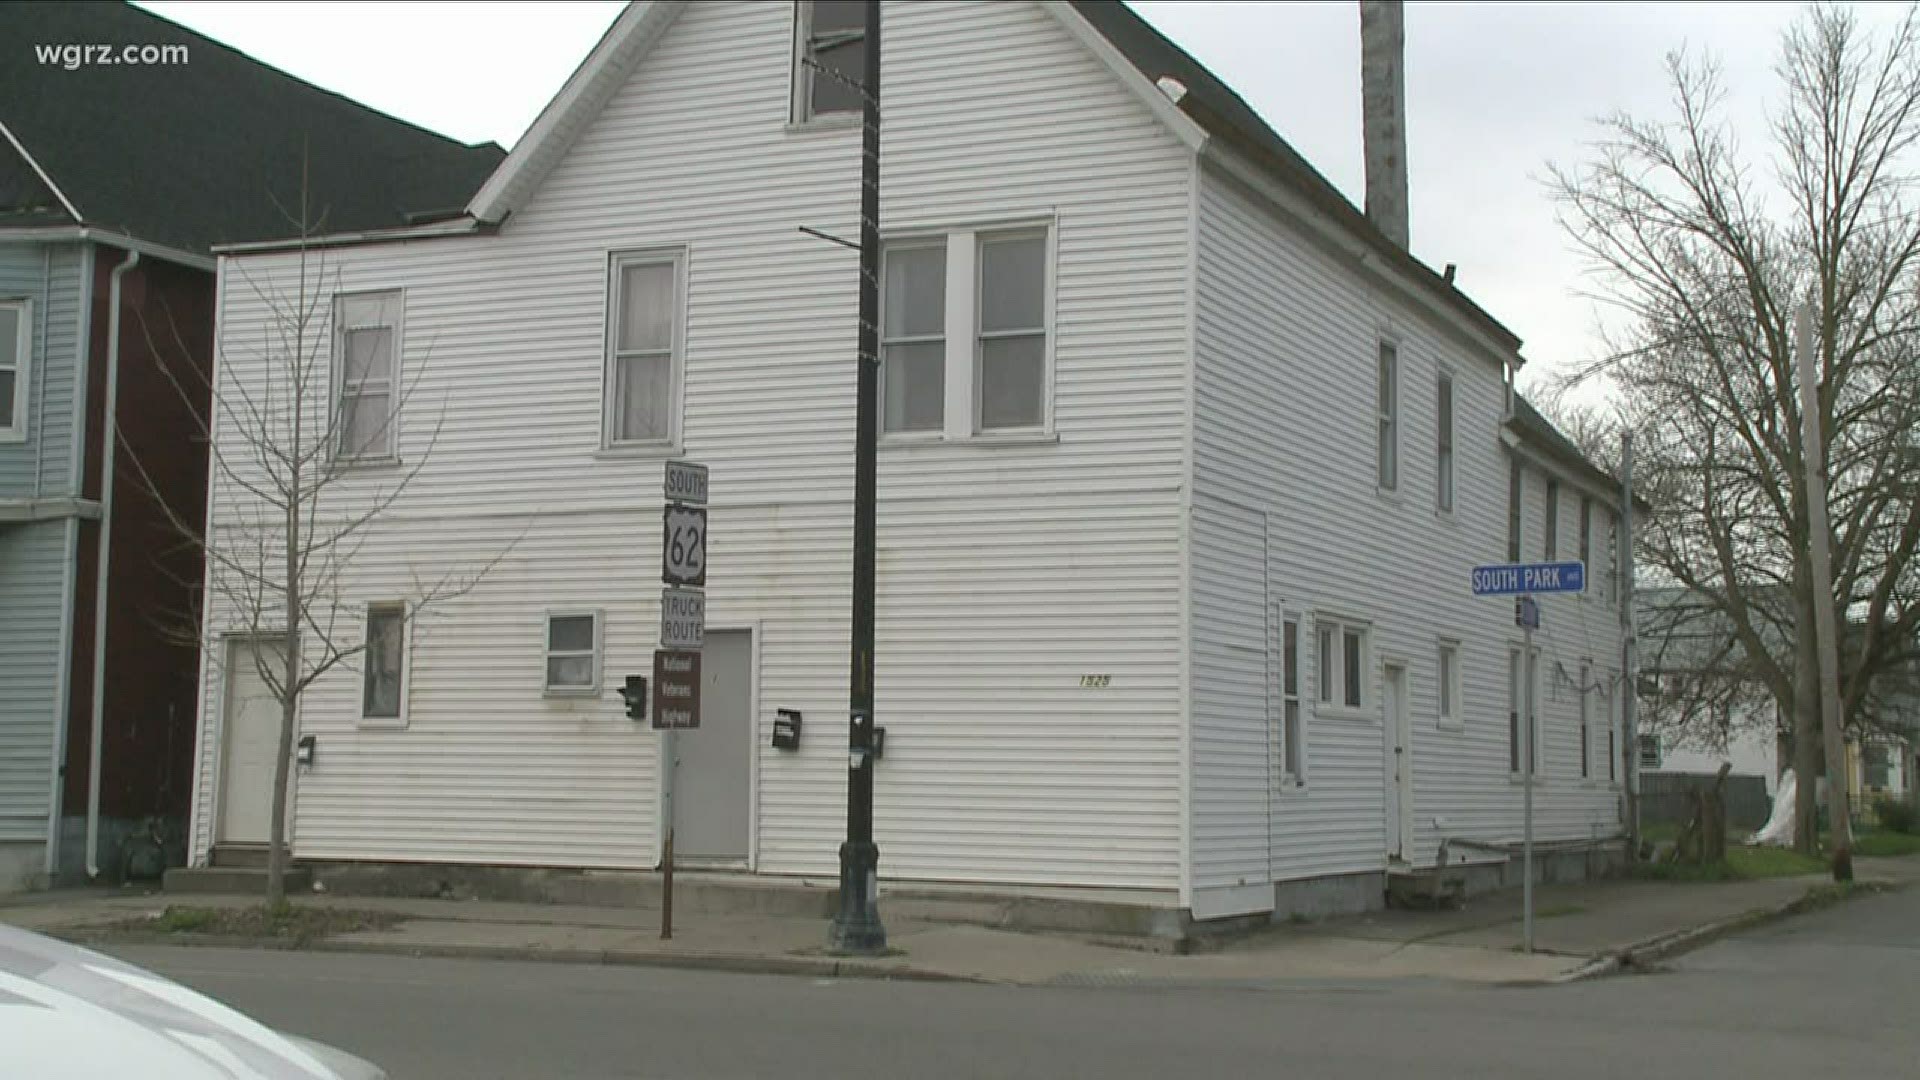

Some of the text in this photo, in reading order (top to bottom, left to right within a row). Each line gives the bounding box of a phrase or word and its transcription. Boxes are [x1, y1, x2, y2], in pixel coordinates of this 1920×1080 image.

[669, 469, 706, 494] SOUTH
[671, 525, 699, 568] 62
[1473, 569, 1518, 592] SOUTH
[1524, 567, 1561, 589] PARK
[665, 596, 701, 616] TRUCK
[664, 620, 702, 641] ROUTE
